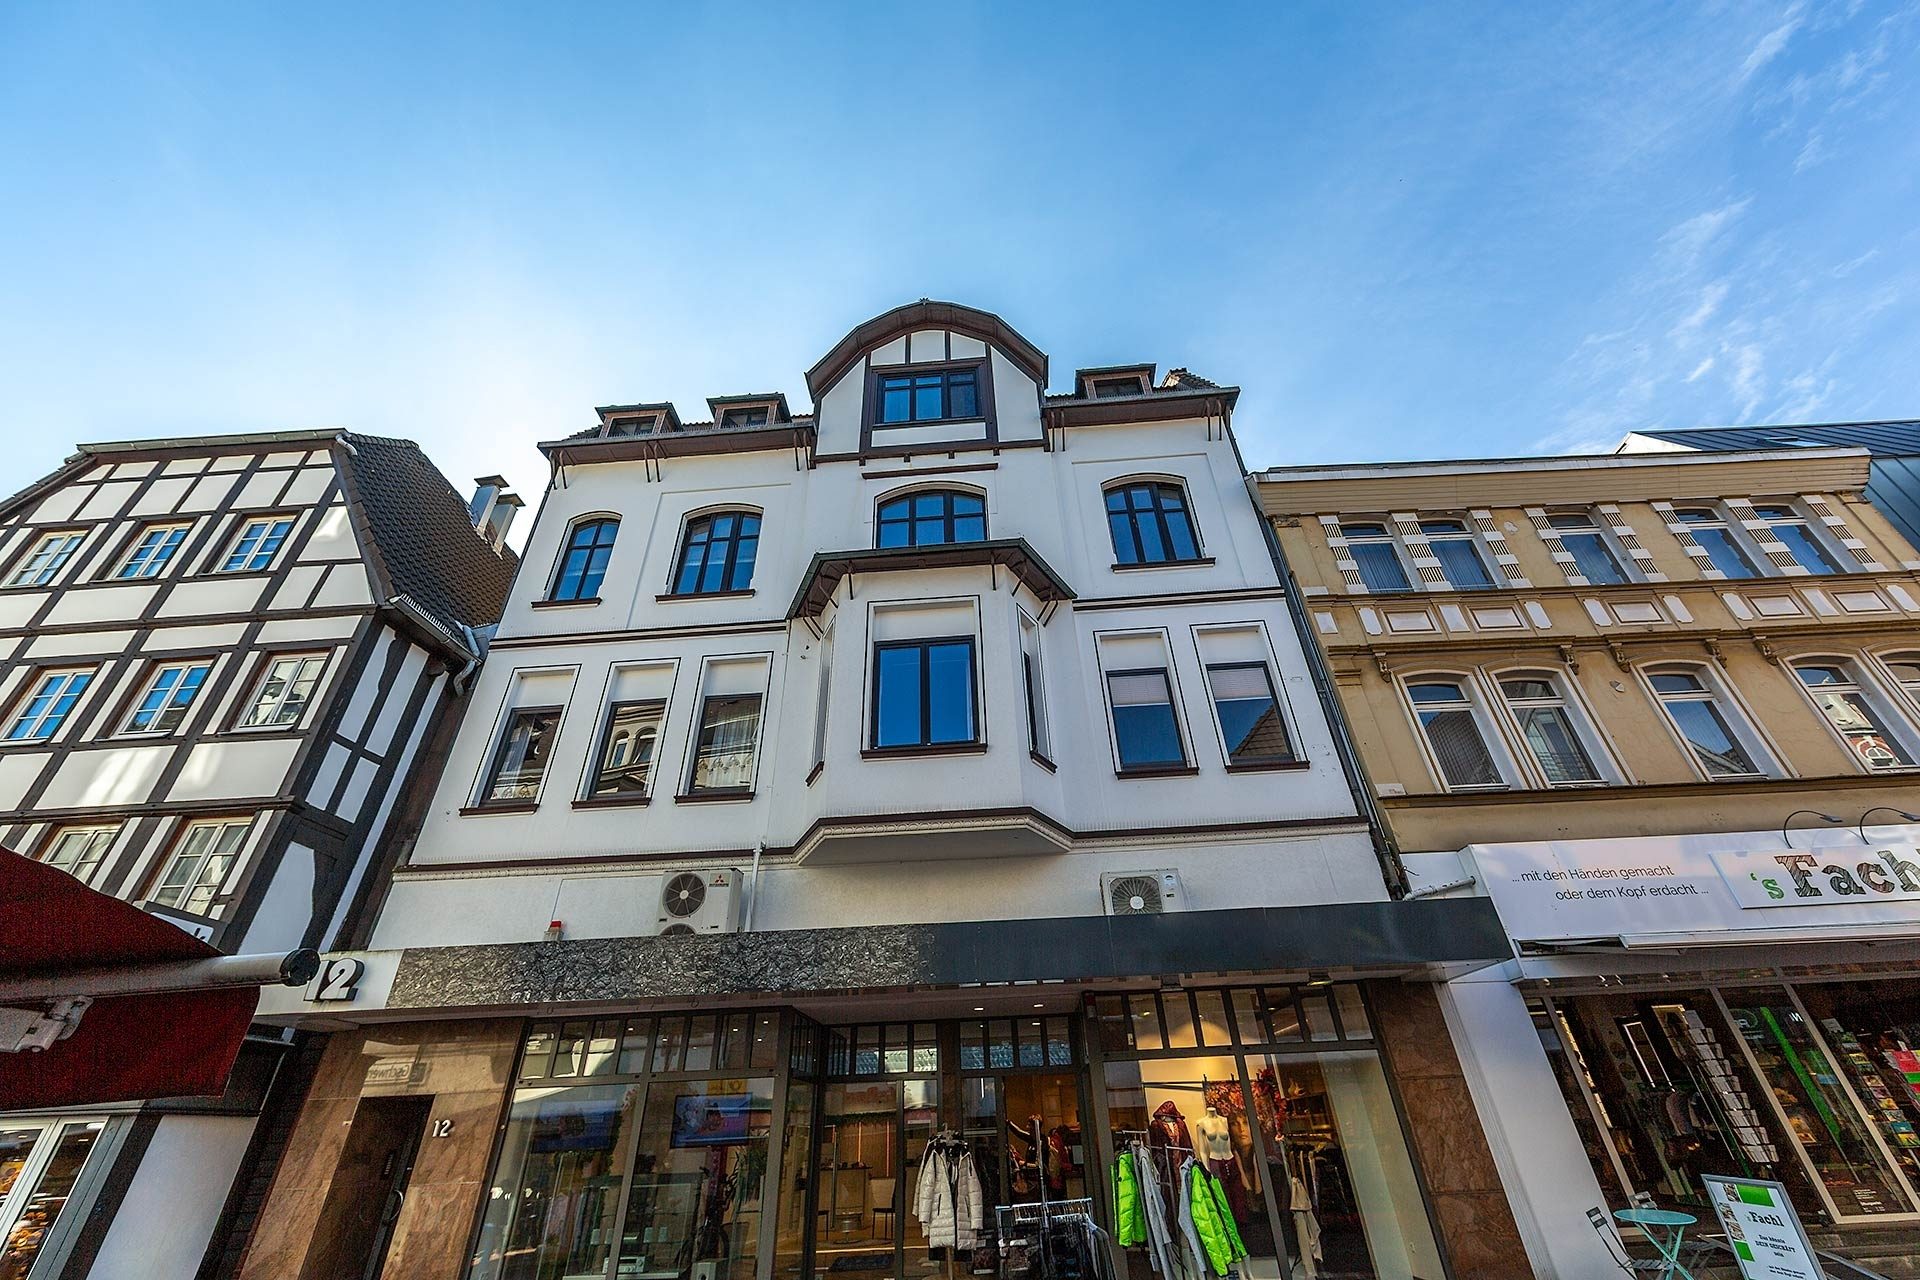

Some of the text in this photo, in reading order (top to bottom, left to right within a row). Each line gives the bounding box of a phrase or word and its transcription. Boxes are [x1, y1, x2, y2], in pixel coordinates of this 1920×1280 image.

[1543, 870, 1568, 881] den
[1568, 867, 1618, 880] Händen
[1620, 865, 1675, 880] gemacht
[1774, 849, 1920, 898] Fach
[1555, 889, 1584, 900] oder
[1586, 888, 1617, 899] dem
[1616, 885, 1647, 900] Kopf
[304, 957, 364, 1001] 12
[431, 1119, 452, 1138] 12
[1748, 1211, 1785, 1227] Fachl
